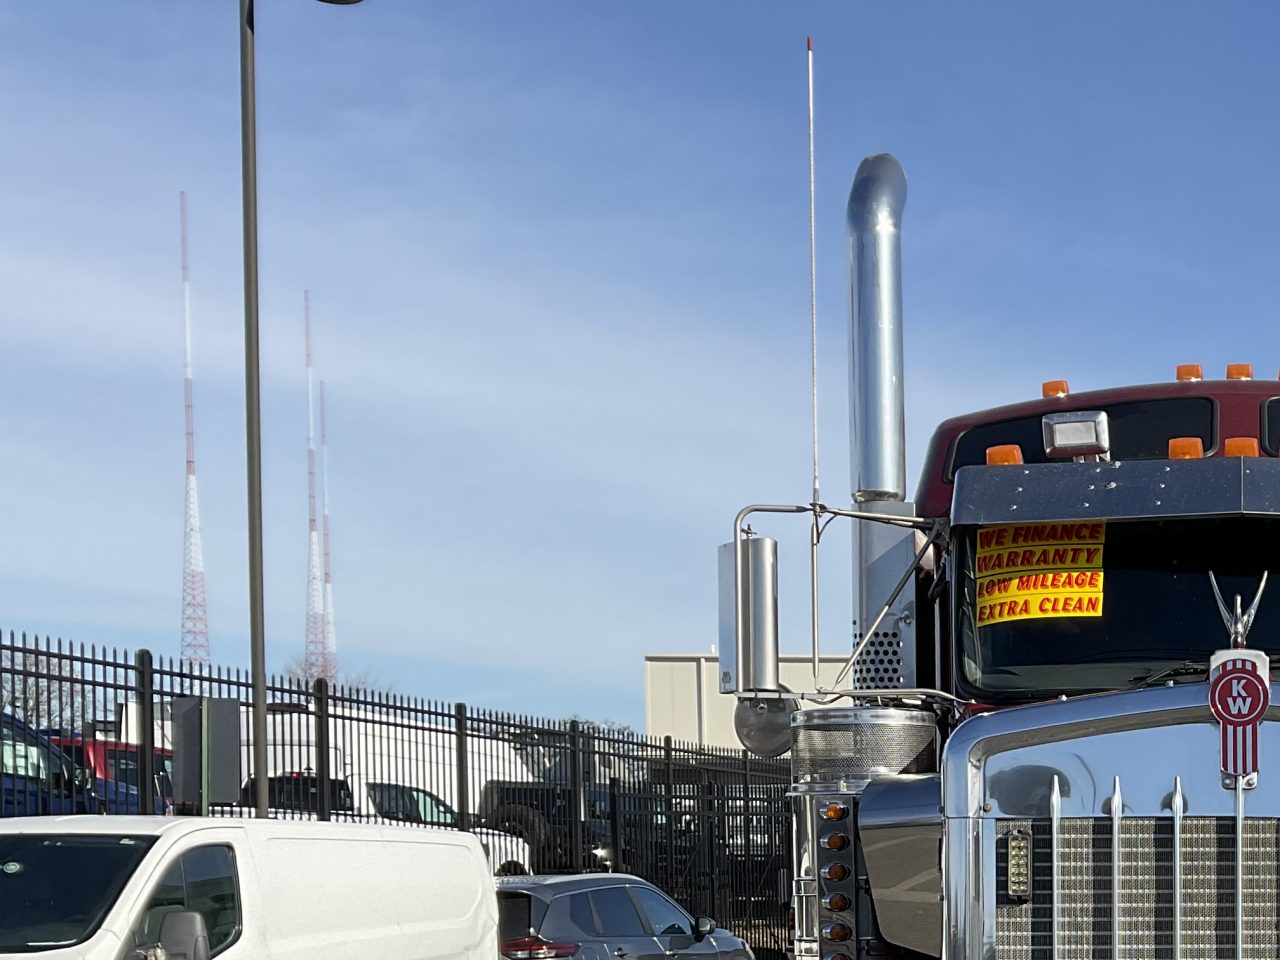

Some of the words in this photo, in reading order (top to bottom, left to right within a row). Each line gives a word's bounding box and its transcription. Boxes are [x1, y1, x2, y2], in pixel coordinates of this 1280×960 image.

[979, 528, 1008, 549] WE
[1011, 523, 1103, 545] FINANCE
[977, 547, 1100, 574] WARRANTY
[978, 576, 1012, 598] LOW
[1016, 571, 1100, 592] MILEAGE
[978, 599, 1031, 623] EXTRA
[1038, 597, 1100, 614] CLEAN
